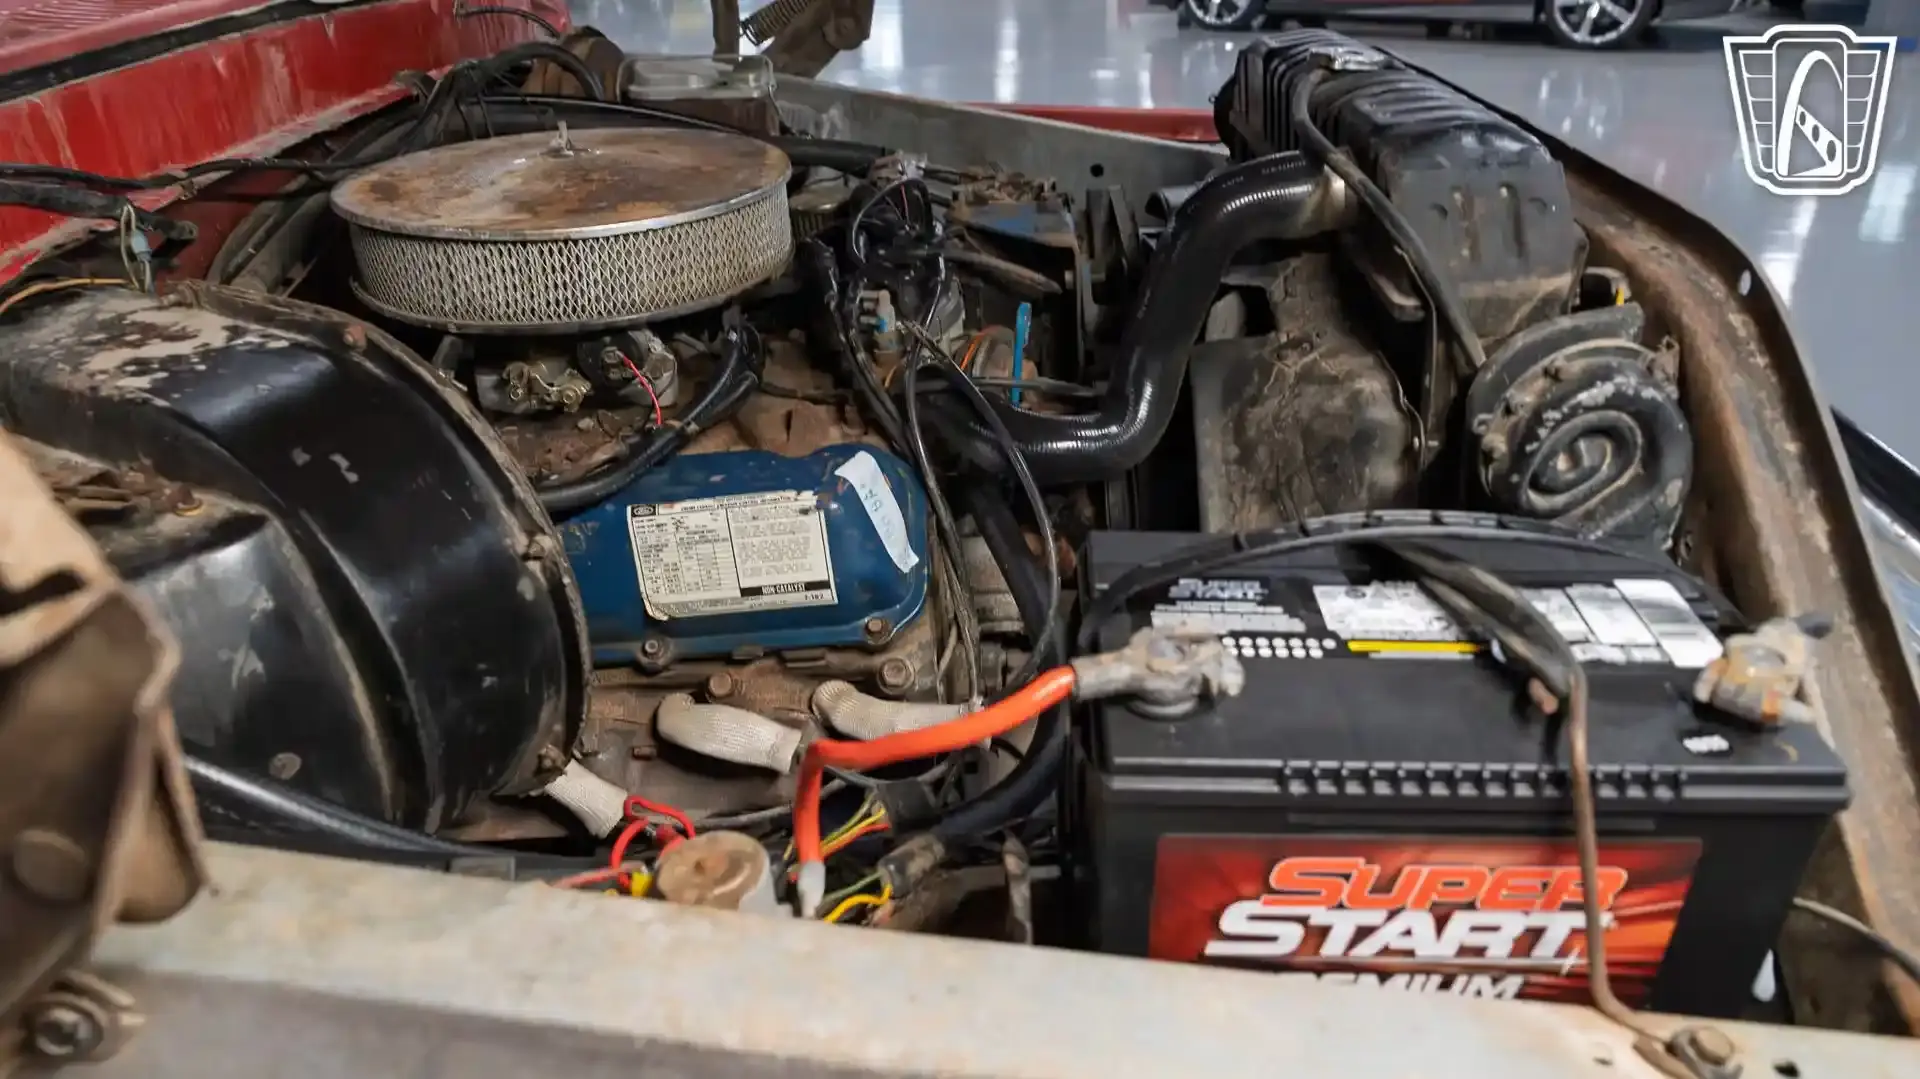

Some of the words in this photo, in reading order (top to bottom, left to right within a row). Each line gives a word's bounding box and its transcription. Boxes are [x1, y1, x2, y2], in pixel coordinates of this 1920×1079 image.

[1259, 856, 1628, 909] SUPER
[1204, 899, 1610, 958] START
[1283, 971, 1525, 1000] EMIUM
